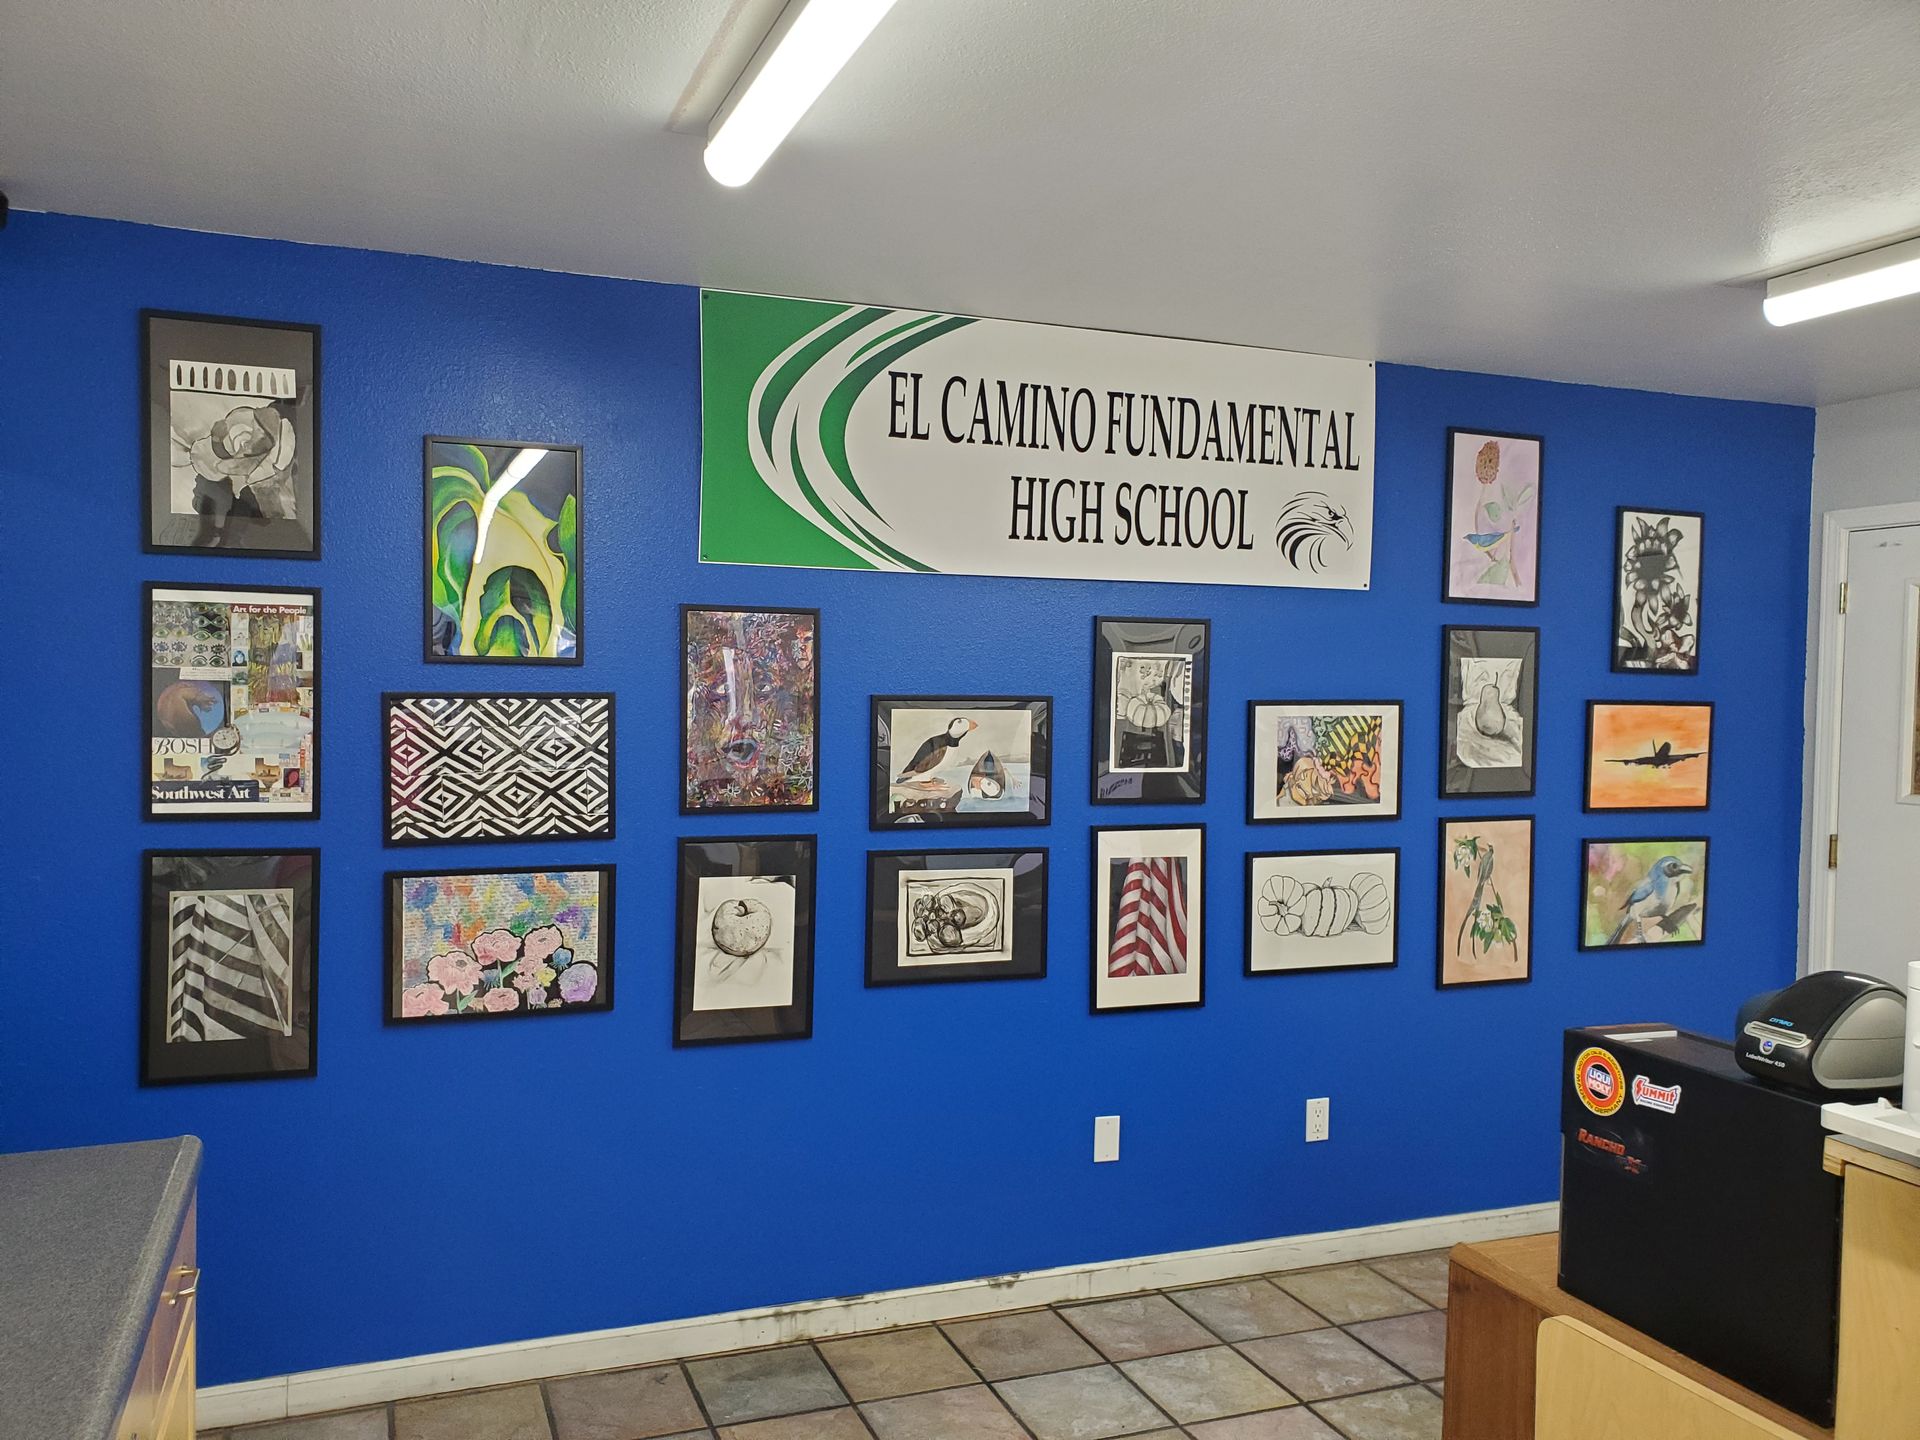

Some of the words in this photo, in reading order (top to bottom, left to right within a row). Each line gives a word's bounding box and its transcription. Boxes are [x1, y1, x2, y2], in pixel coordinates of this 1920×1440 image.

[887, 370, 931, 441] EL
[941, 375, 1097, 453] CAMINO
[1104, 391, 1360, 471] FUNDAMENTAL
[1008, 475, 1106, 544] HIGH
[1114, 482, 1254, 550] SCHOOL
[248, 605, 261, 613] for
[263, 606, 277, 614] the
[279, 606, 307, 615] People
[152, 785, 225, 799] Southwest
[228, 785, 250, 799] Art
[1588, 1067, 1612, 1086] LIQUI
[1588, 1078, 1612, 1096] MOLY
[1578, 1128, 1626, 1156] RANCHO
